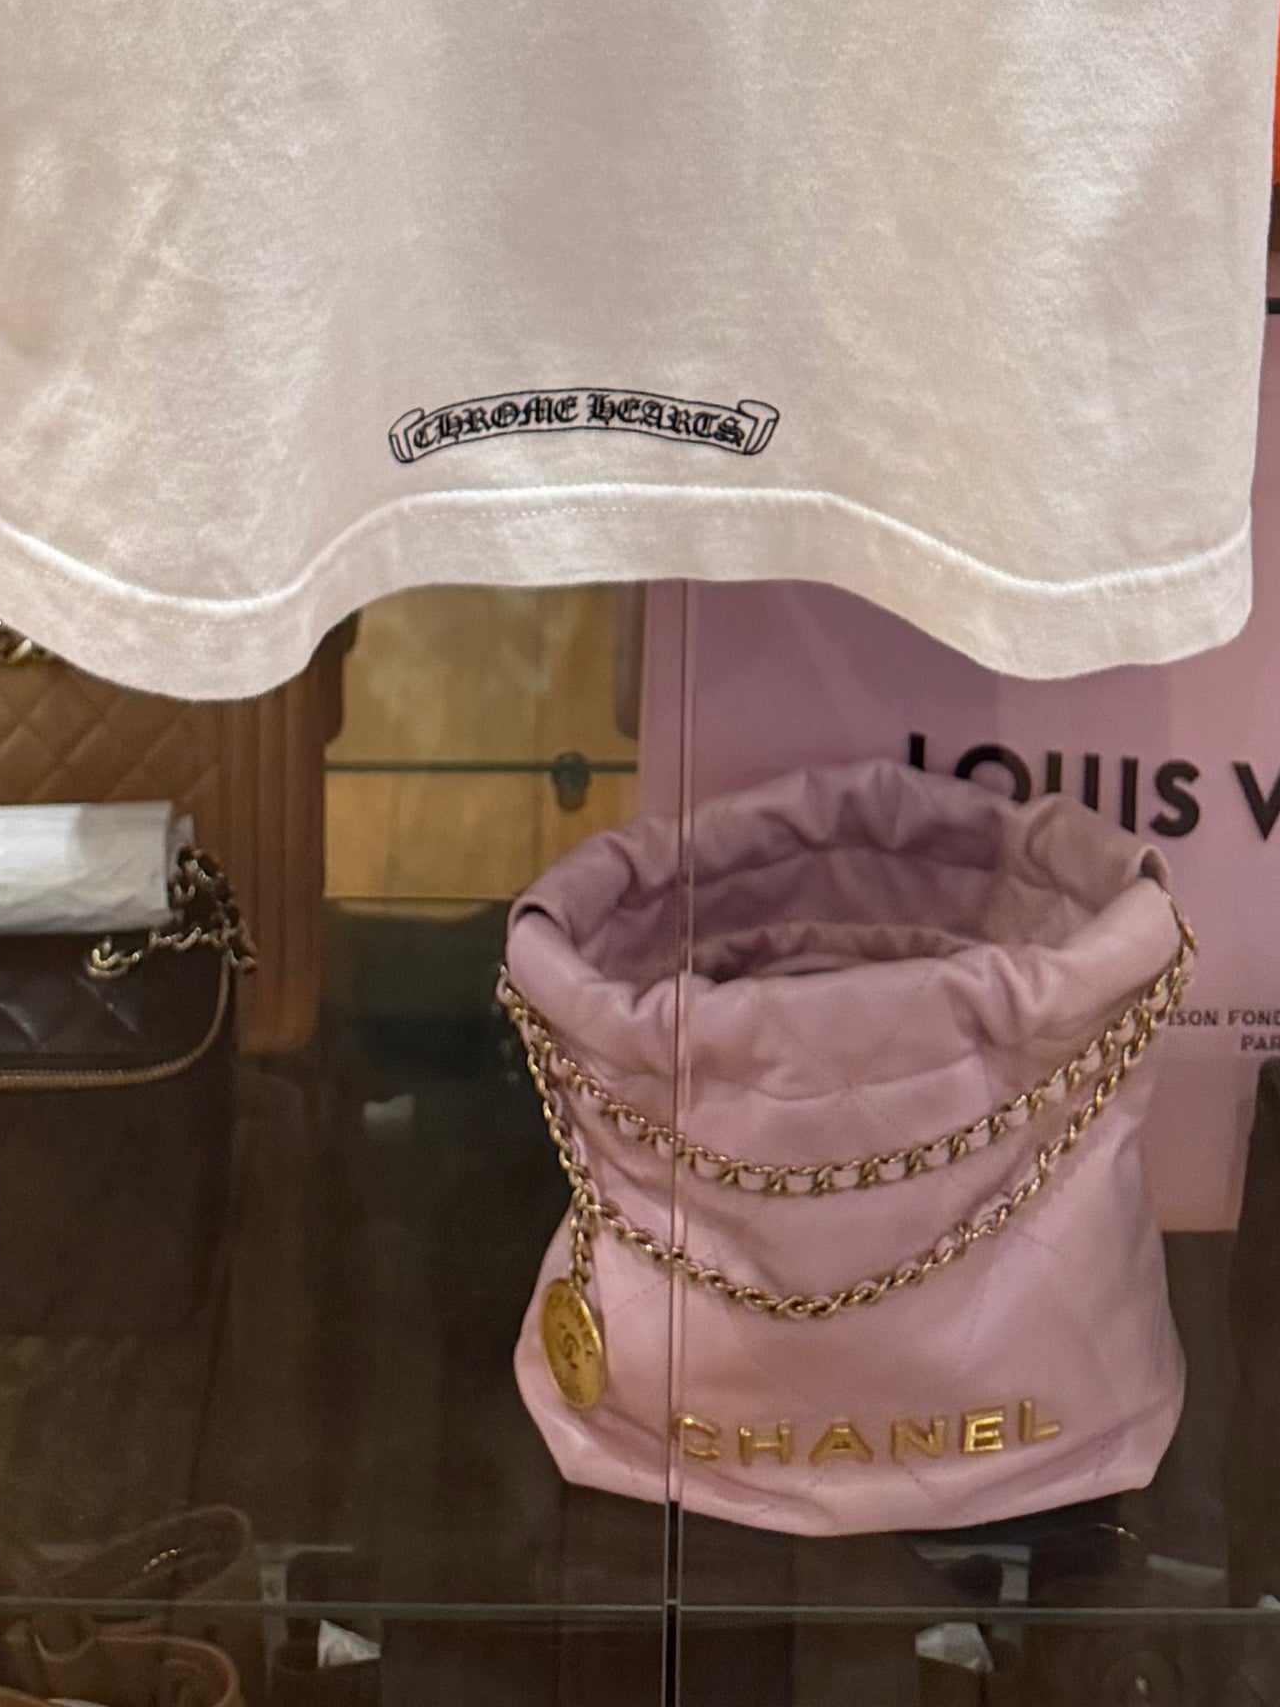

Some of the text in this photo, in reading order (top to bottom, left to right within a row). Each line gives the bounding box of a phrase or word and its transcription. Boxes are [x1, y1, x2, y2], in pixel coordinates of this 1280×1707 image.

[413, 393, 745, 451] CHROME HEARTS
[675, 1398, 1062, 1468] CHANEL
